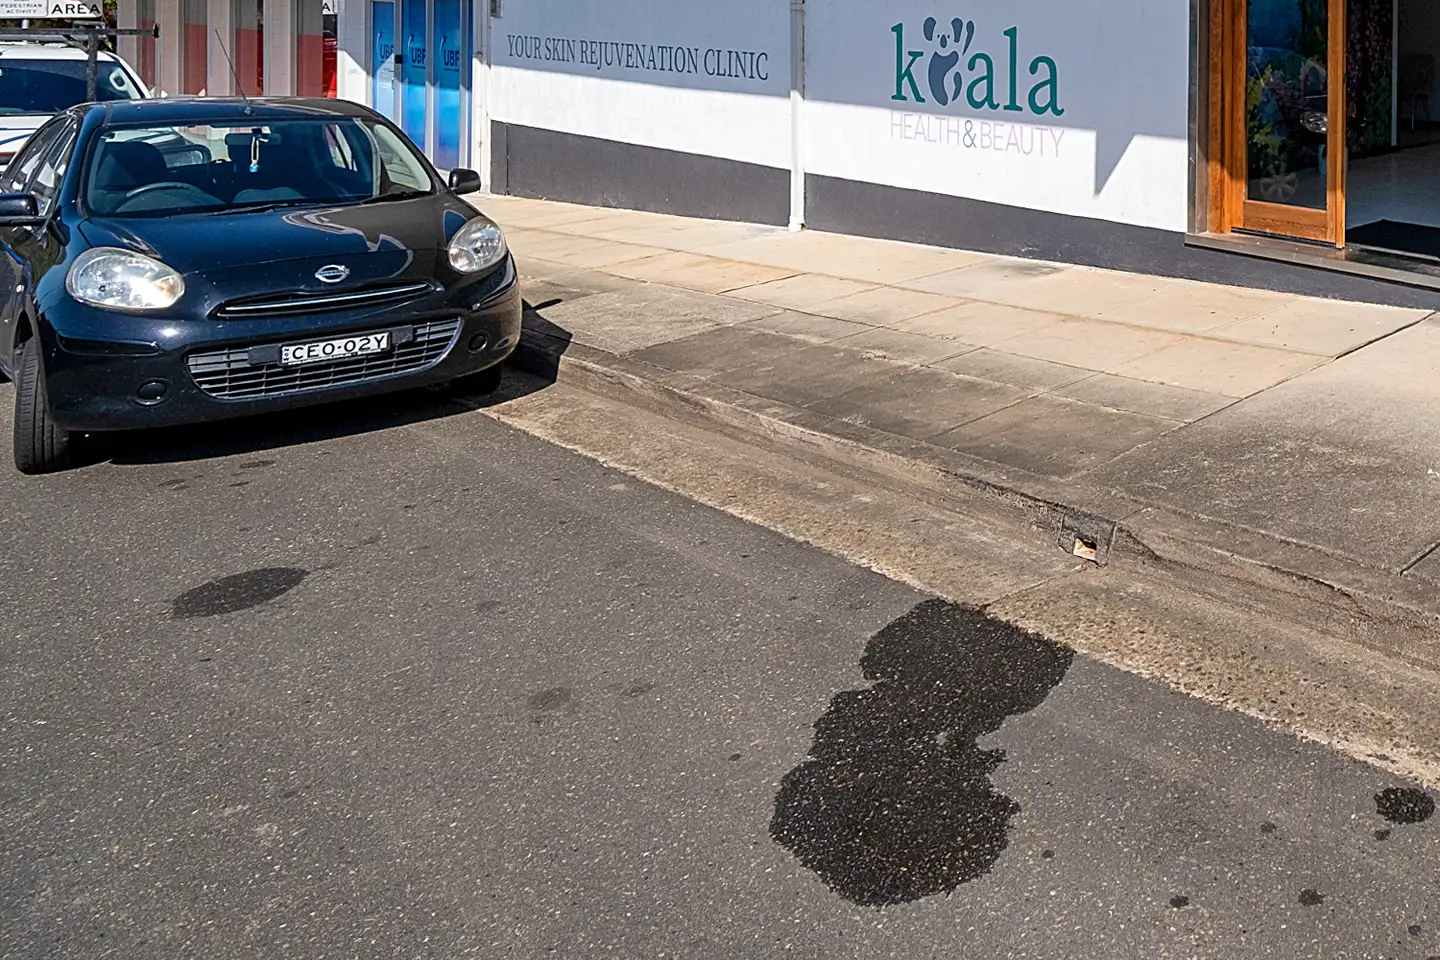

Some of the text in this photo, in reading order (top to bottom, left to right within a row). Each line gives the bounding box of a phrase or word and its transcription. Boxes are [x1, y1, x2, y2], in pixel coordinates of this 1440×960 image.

[51, 4, 101, 15] AREA
[507, 34, 769, 81] YOUR SKIN REJUVENATION CLINIC
